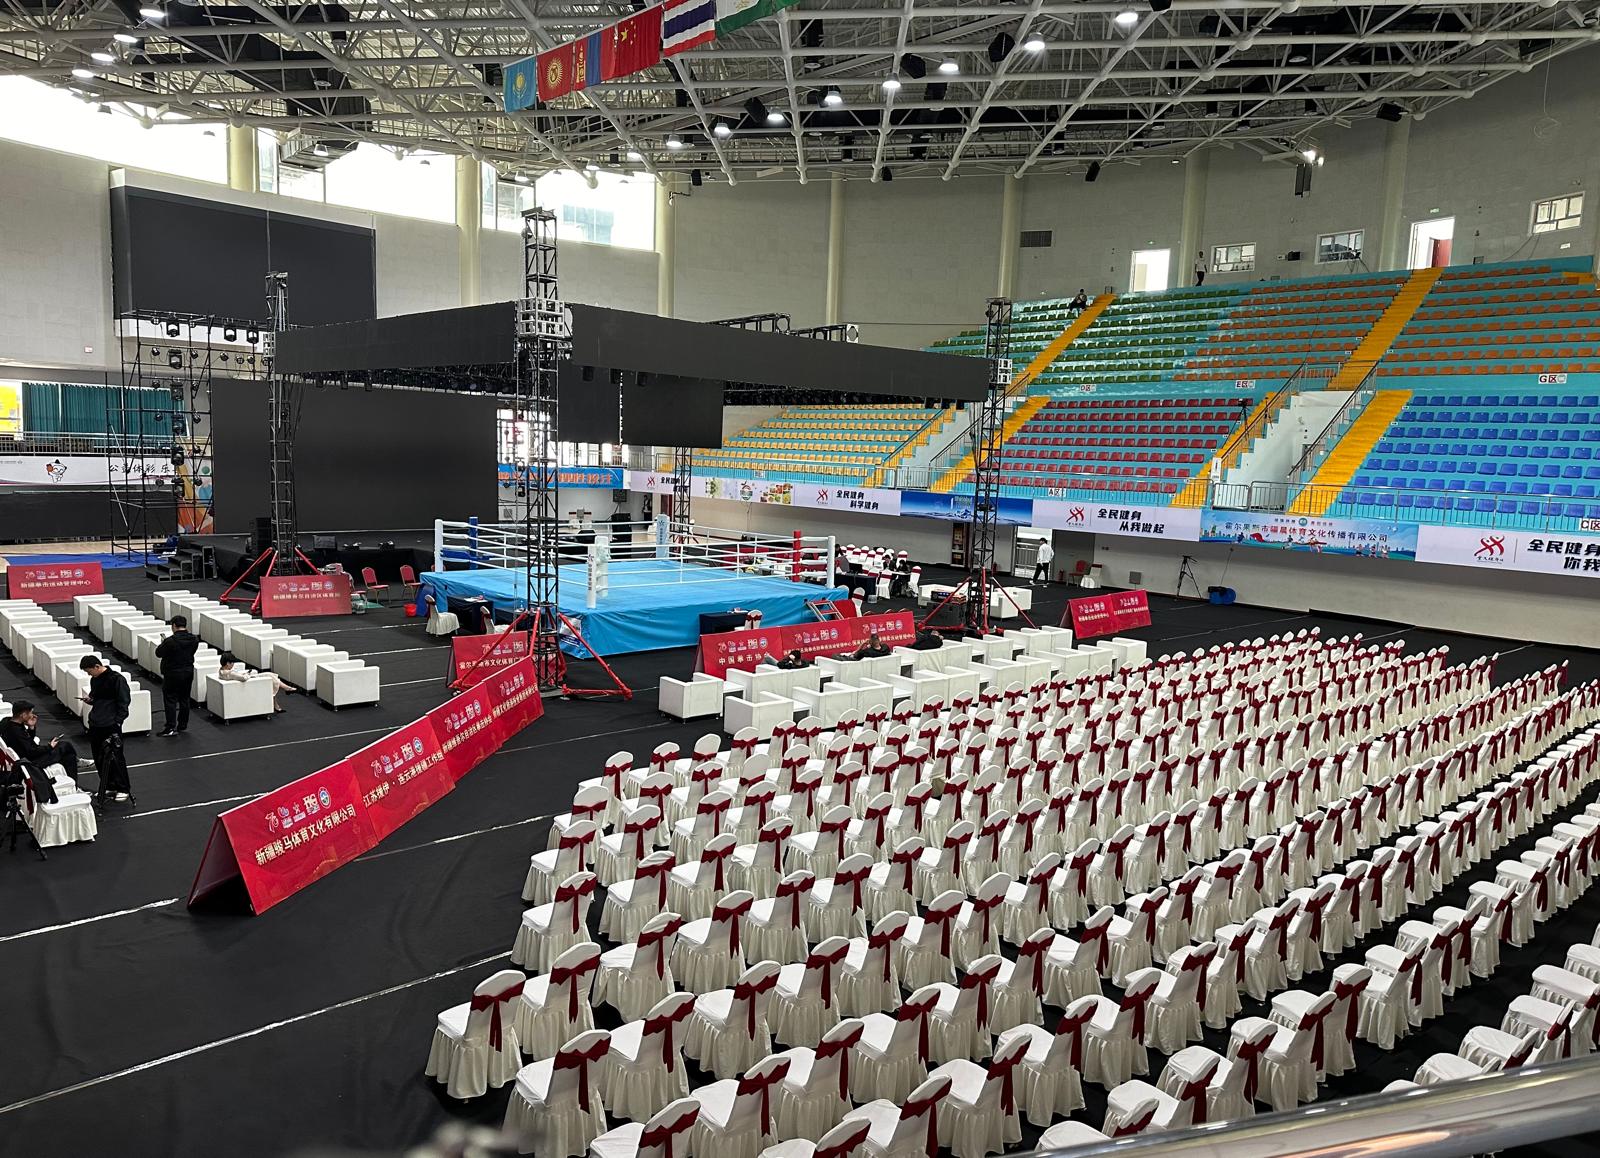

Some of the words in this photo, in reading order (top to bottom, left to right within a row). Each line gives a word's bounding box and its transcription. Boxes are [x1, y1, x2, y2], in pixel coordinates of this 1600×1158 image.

[836, 490, 865, 501] 全民健身
[849, 500, 879, 511] 科学健身
[1097, 508, 1142, 521] 全民健身
[1119, 521, 1165, 534] 从我做起
[254, 803, 357, 866] 新疆骏马体育文化有限公司
